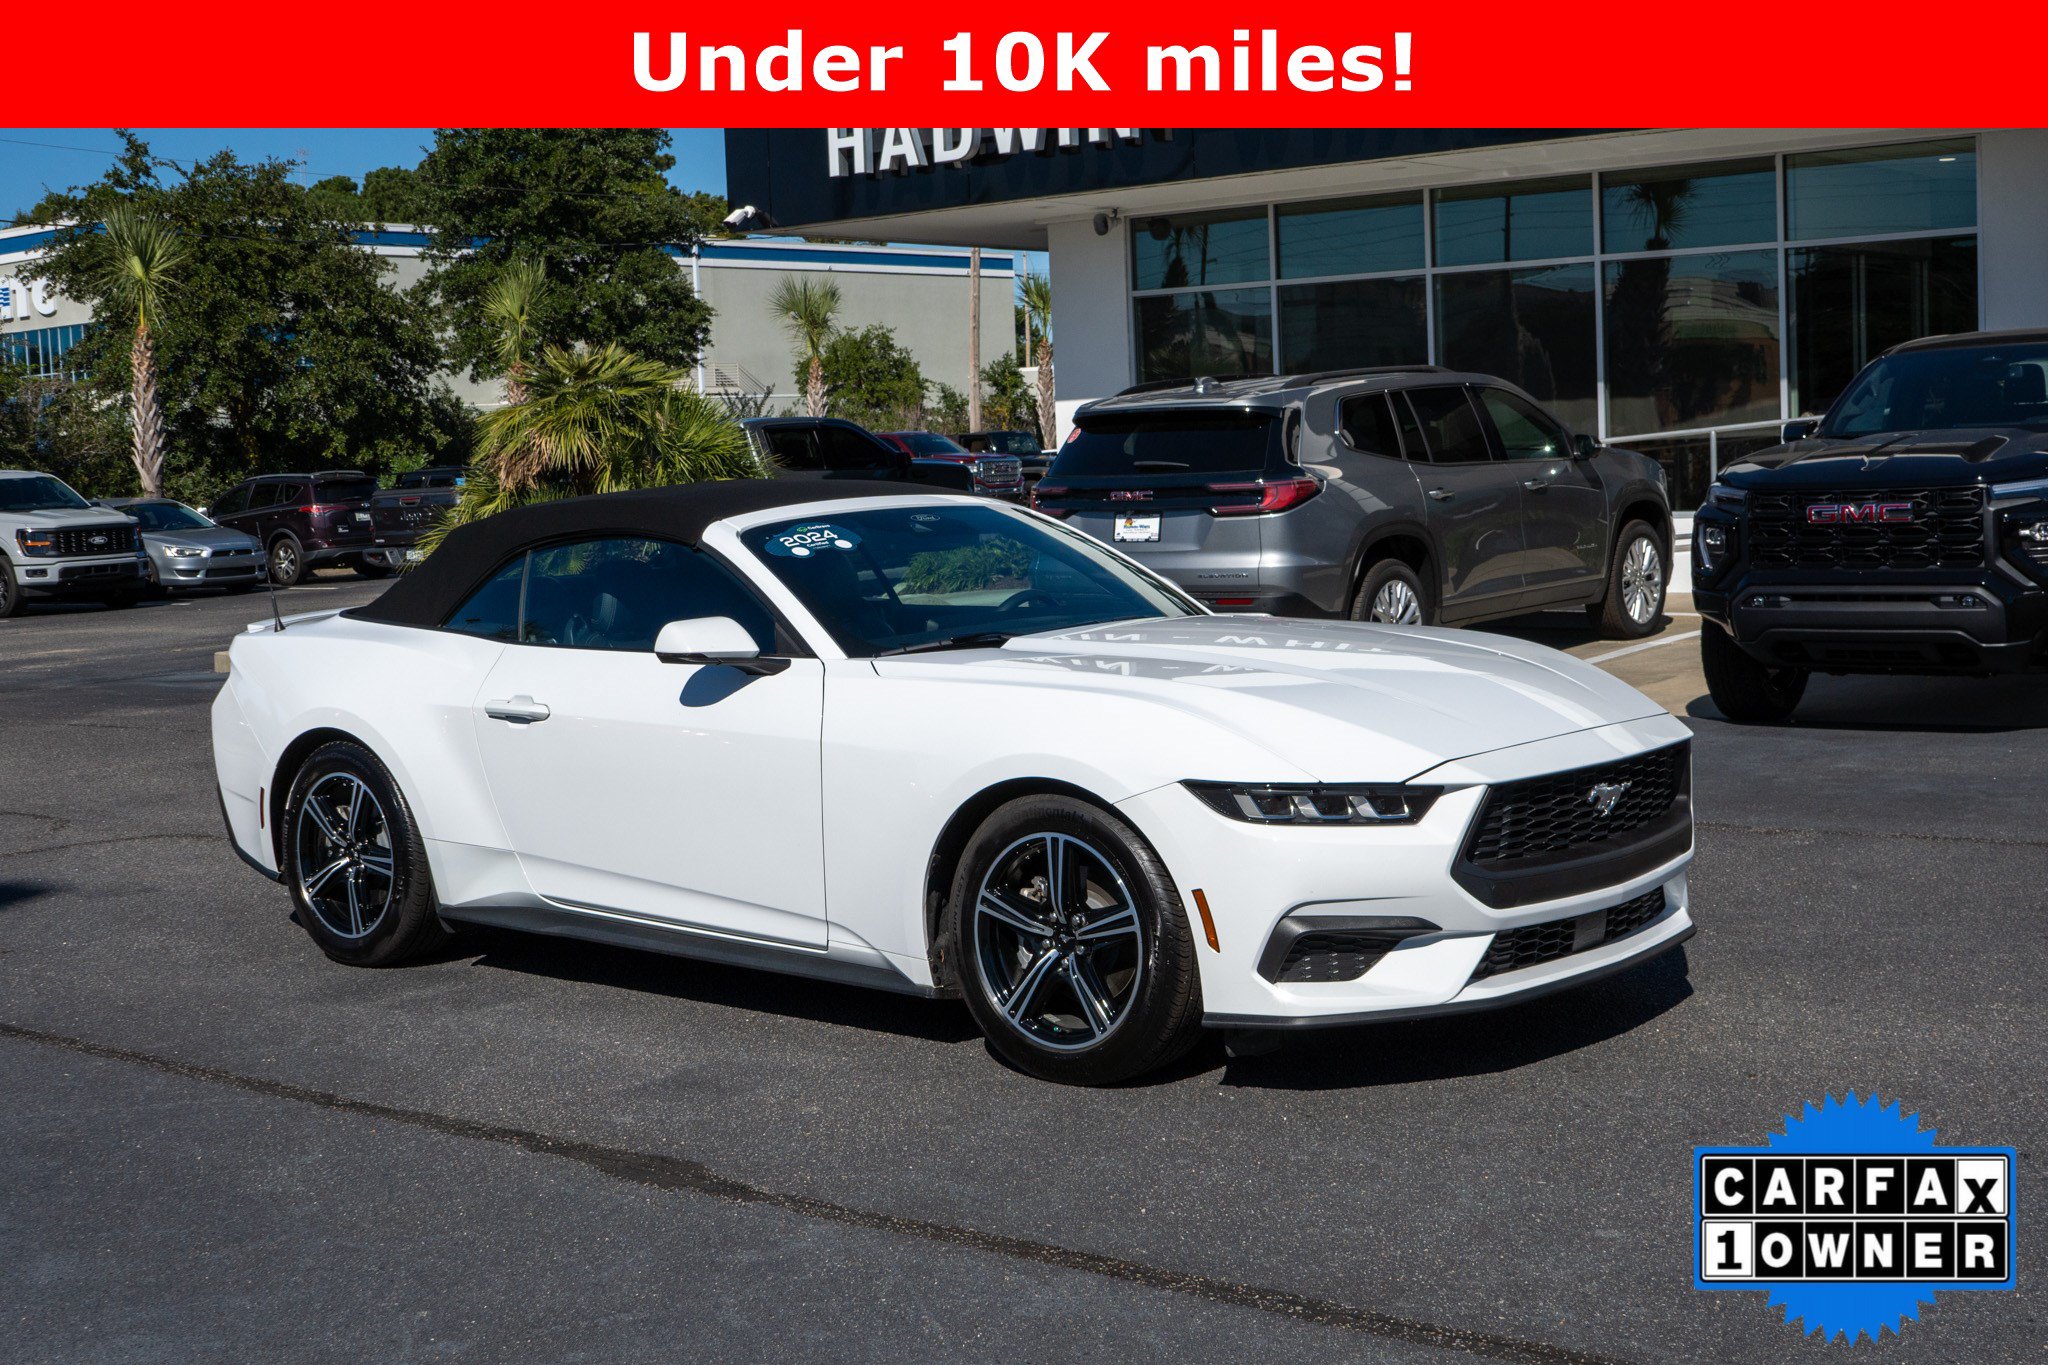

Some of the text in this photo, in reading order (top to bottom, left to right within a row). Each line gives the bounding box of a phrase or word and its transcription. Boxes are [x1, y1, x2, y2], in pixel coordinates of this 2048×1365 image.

[828, 128, 1140, 178] HAD
[1110, 490, 1153, 501] GMC
[1806, 502, 1913, 523] GMC
[779, 529, 838, 547] 2024
